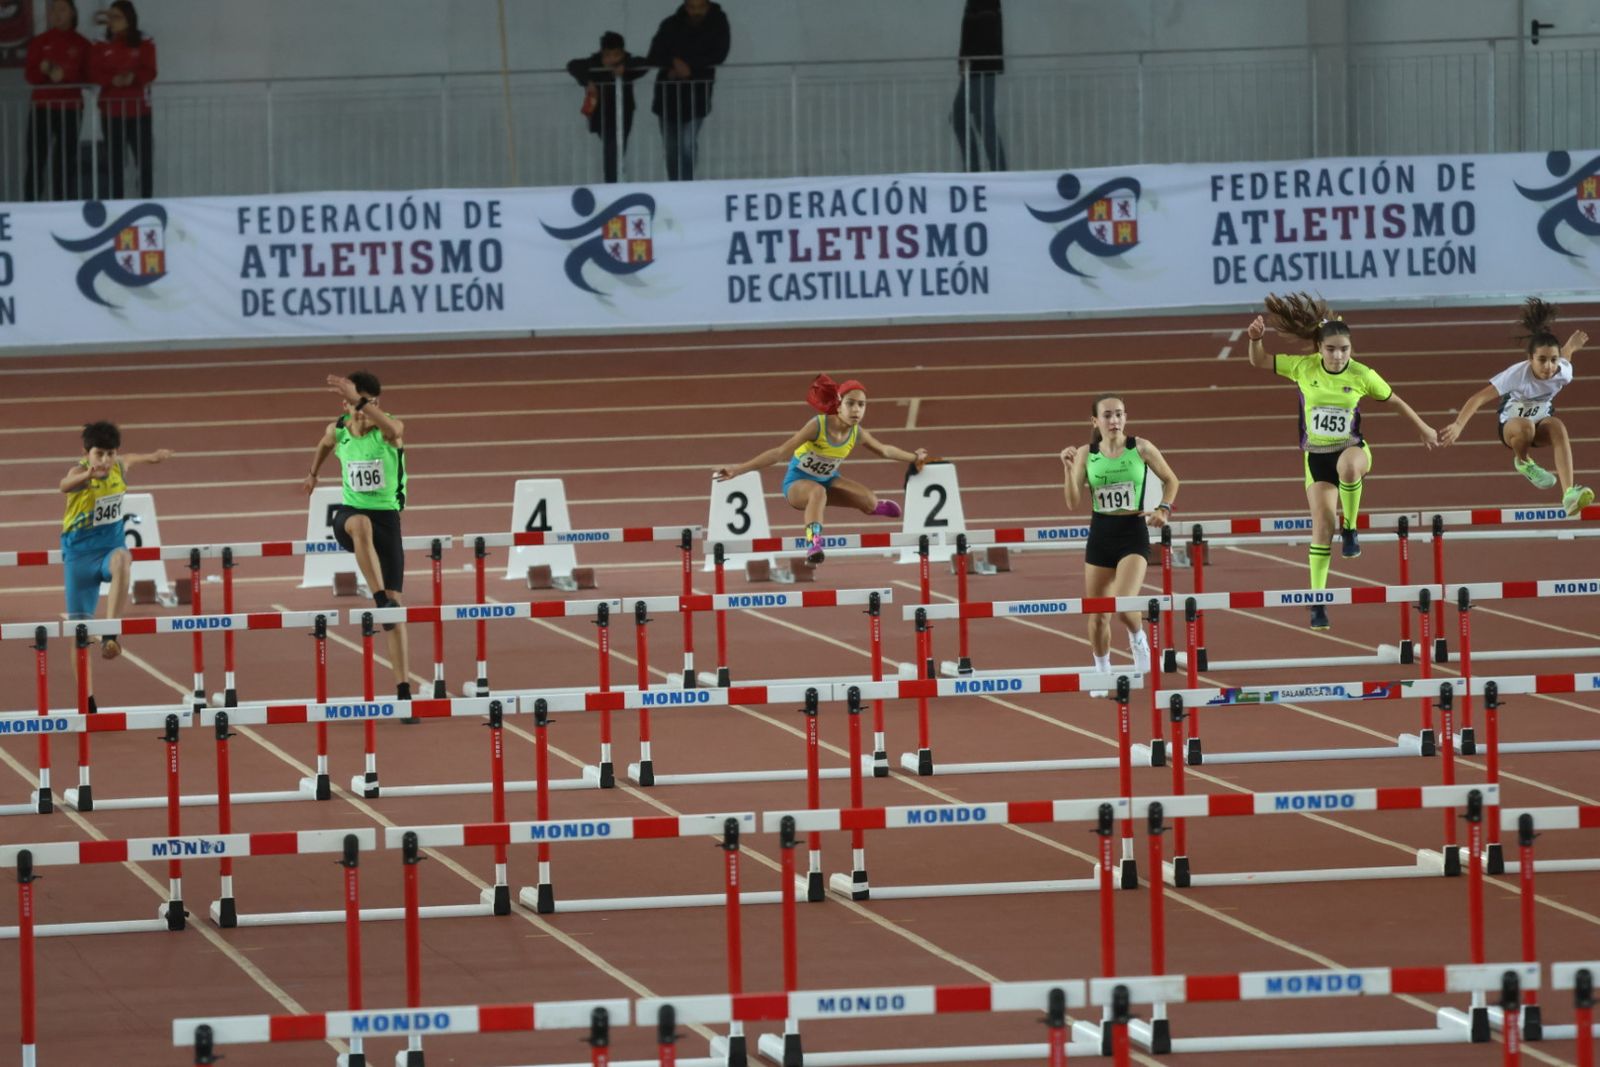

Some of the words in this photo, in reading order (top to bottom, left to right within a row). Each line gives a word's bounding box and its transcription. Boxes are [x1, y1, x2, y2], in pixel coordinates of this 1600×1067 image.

[1211, 161, 1414, 201] FEDERACIÓN
[1438, 163, 1476, 191] DE
[726, 182, 927, 221] FEDERACIÓN
[950, 186, 988, 213] DE
[238, 197, 441, 234] FEDERACIÓN
[464, 201, 502, 229] DE
[1212, 201, 1476, 245] ATLETISMO
[727, 222, 988, 264] ATLETISMO
[240, 239, 502, 278] ATLETISMO
[1214, 256, 1247, 284] DE
[1254, 249, 1378, 282] CASTILLA
[1382, 249, 1401, 277] Y
[1407, 246, 1476, 275] LEÓN
[728, 275, 762, 303] DE
[768, 270, 892, 301] CASTILLA
[896, 269, 914, 296] Y
[921, 266, 988, 295] LEÓN
[242, 289, 275, 317] DE
[282, 285, 405, 316] CASTILLA
[411, 285, 429, 312] Y
[437, 278, 503, 311] LEÓN
[1313, 414, 1346, 432] 1453
[803, 457, 835, 475] 3452
[351, 470, 380, 486] 1196
[924, 484, 949, 527] 2
[1098, 491, 1130, 508] 1191
[526, 499, 552, 531] 4
[727, 492, 751, 535] 3
[1515, 509, 1567, 520] MONDO
[1274, 519, 1313, 529] MOND
[566, 532, 610, 541] MONDO
[1038, 527, 1089, 539] MONDO
[795, 537, 847, 548] MDO
[1555, 583, 1600, 593] MOND
[729, 594, 786, 607] MONDO
[1281, 593, 1334, 604] MONDO
[457, 605, 515, 618] MONDO
[1019, 603, 1067, 613] MONDO
[172, 617, 232, 629] MONDO
[955, 678, 1022, 693] MONDO
[642, 690, 709, 705] MONDO
[326, 703, 393, 718] MONDO
[0, 719, 68, 733] MONDO
[1276, 794, 1355, 810] MONDO
[908, 807, 987, 823] MONDO
[531, 822, 611, 839] MONDO
[1266, 975, 1363, 994] MONDO
[818, 995, 905, 1012] MONDO
[353, 1013, 450, 1032] MONDO
